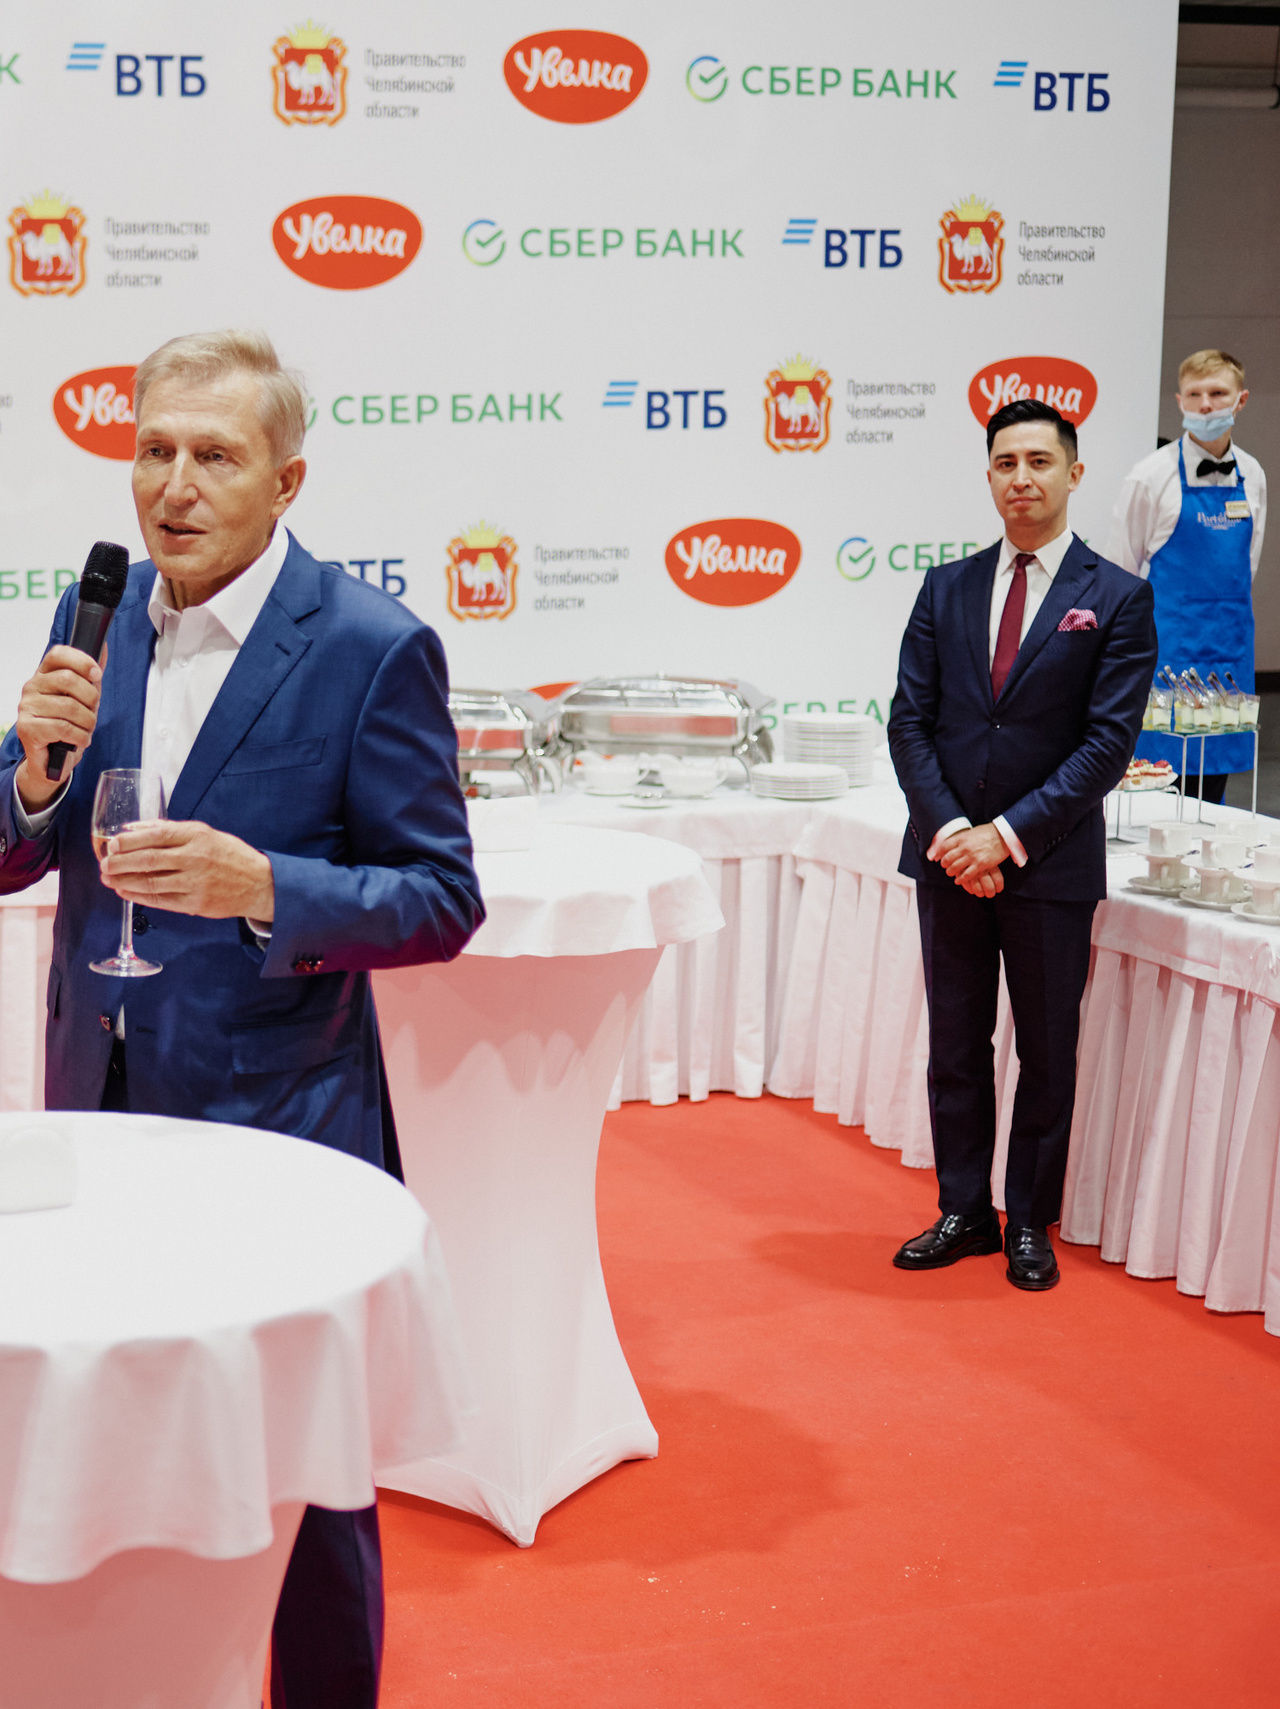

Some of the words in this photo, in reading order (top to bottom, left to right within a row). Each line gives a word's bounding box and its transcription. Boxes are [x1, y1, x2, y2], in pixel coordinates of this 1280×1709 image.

[116, 55, 206, 97] ВТБ
[514, 46, 633, 92] Увелка
[742, 66, 842, 96] СБЕР
[853, 68, 956, 99] БАНК
[1034, 72, 1110, 112] ВТБ
[282, 212, 407, 259] Увелка
[520, 228, 624, 257] СБЕР
[636, 229, 743, 257] БАНК
[825, 229, 902, 268] ВТБ
[63, 381, 136, 431] Уве
[332, 395, 439, 425] СБЕР
[452, 393, 562, 423] БАНК
[647, 390, 727, 429] ВТБ
[675, 534, 787, 580] Увелка
[321, 558, 406, 597] ТБ
